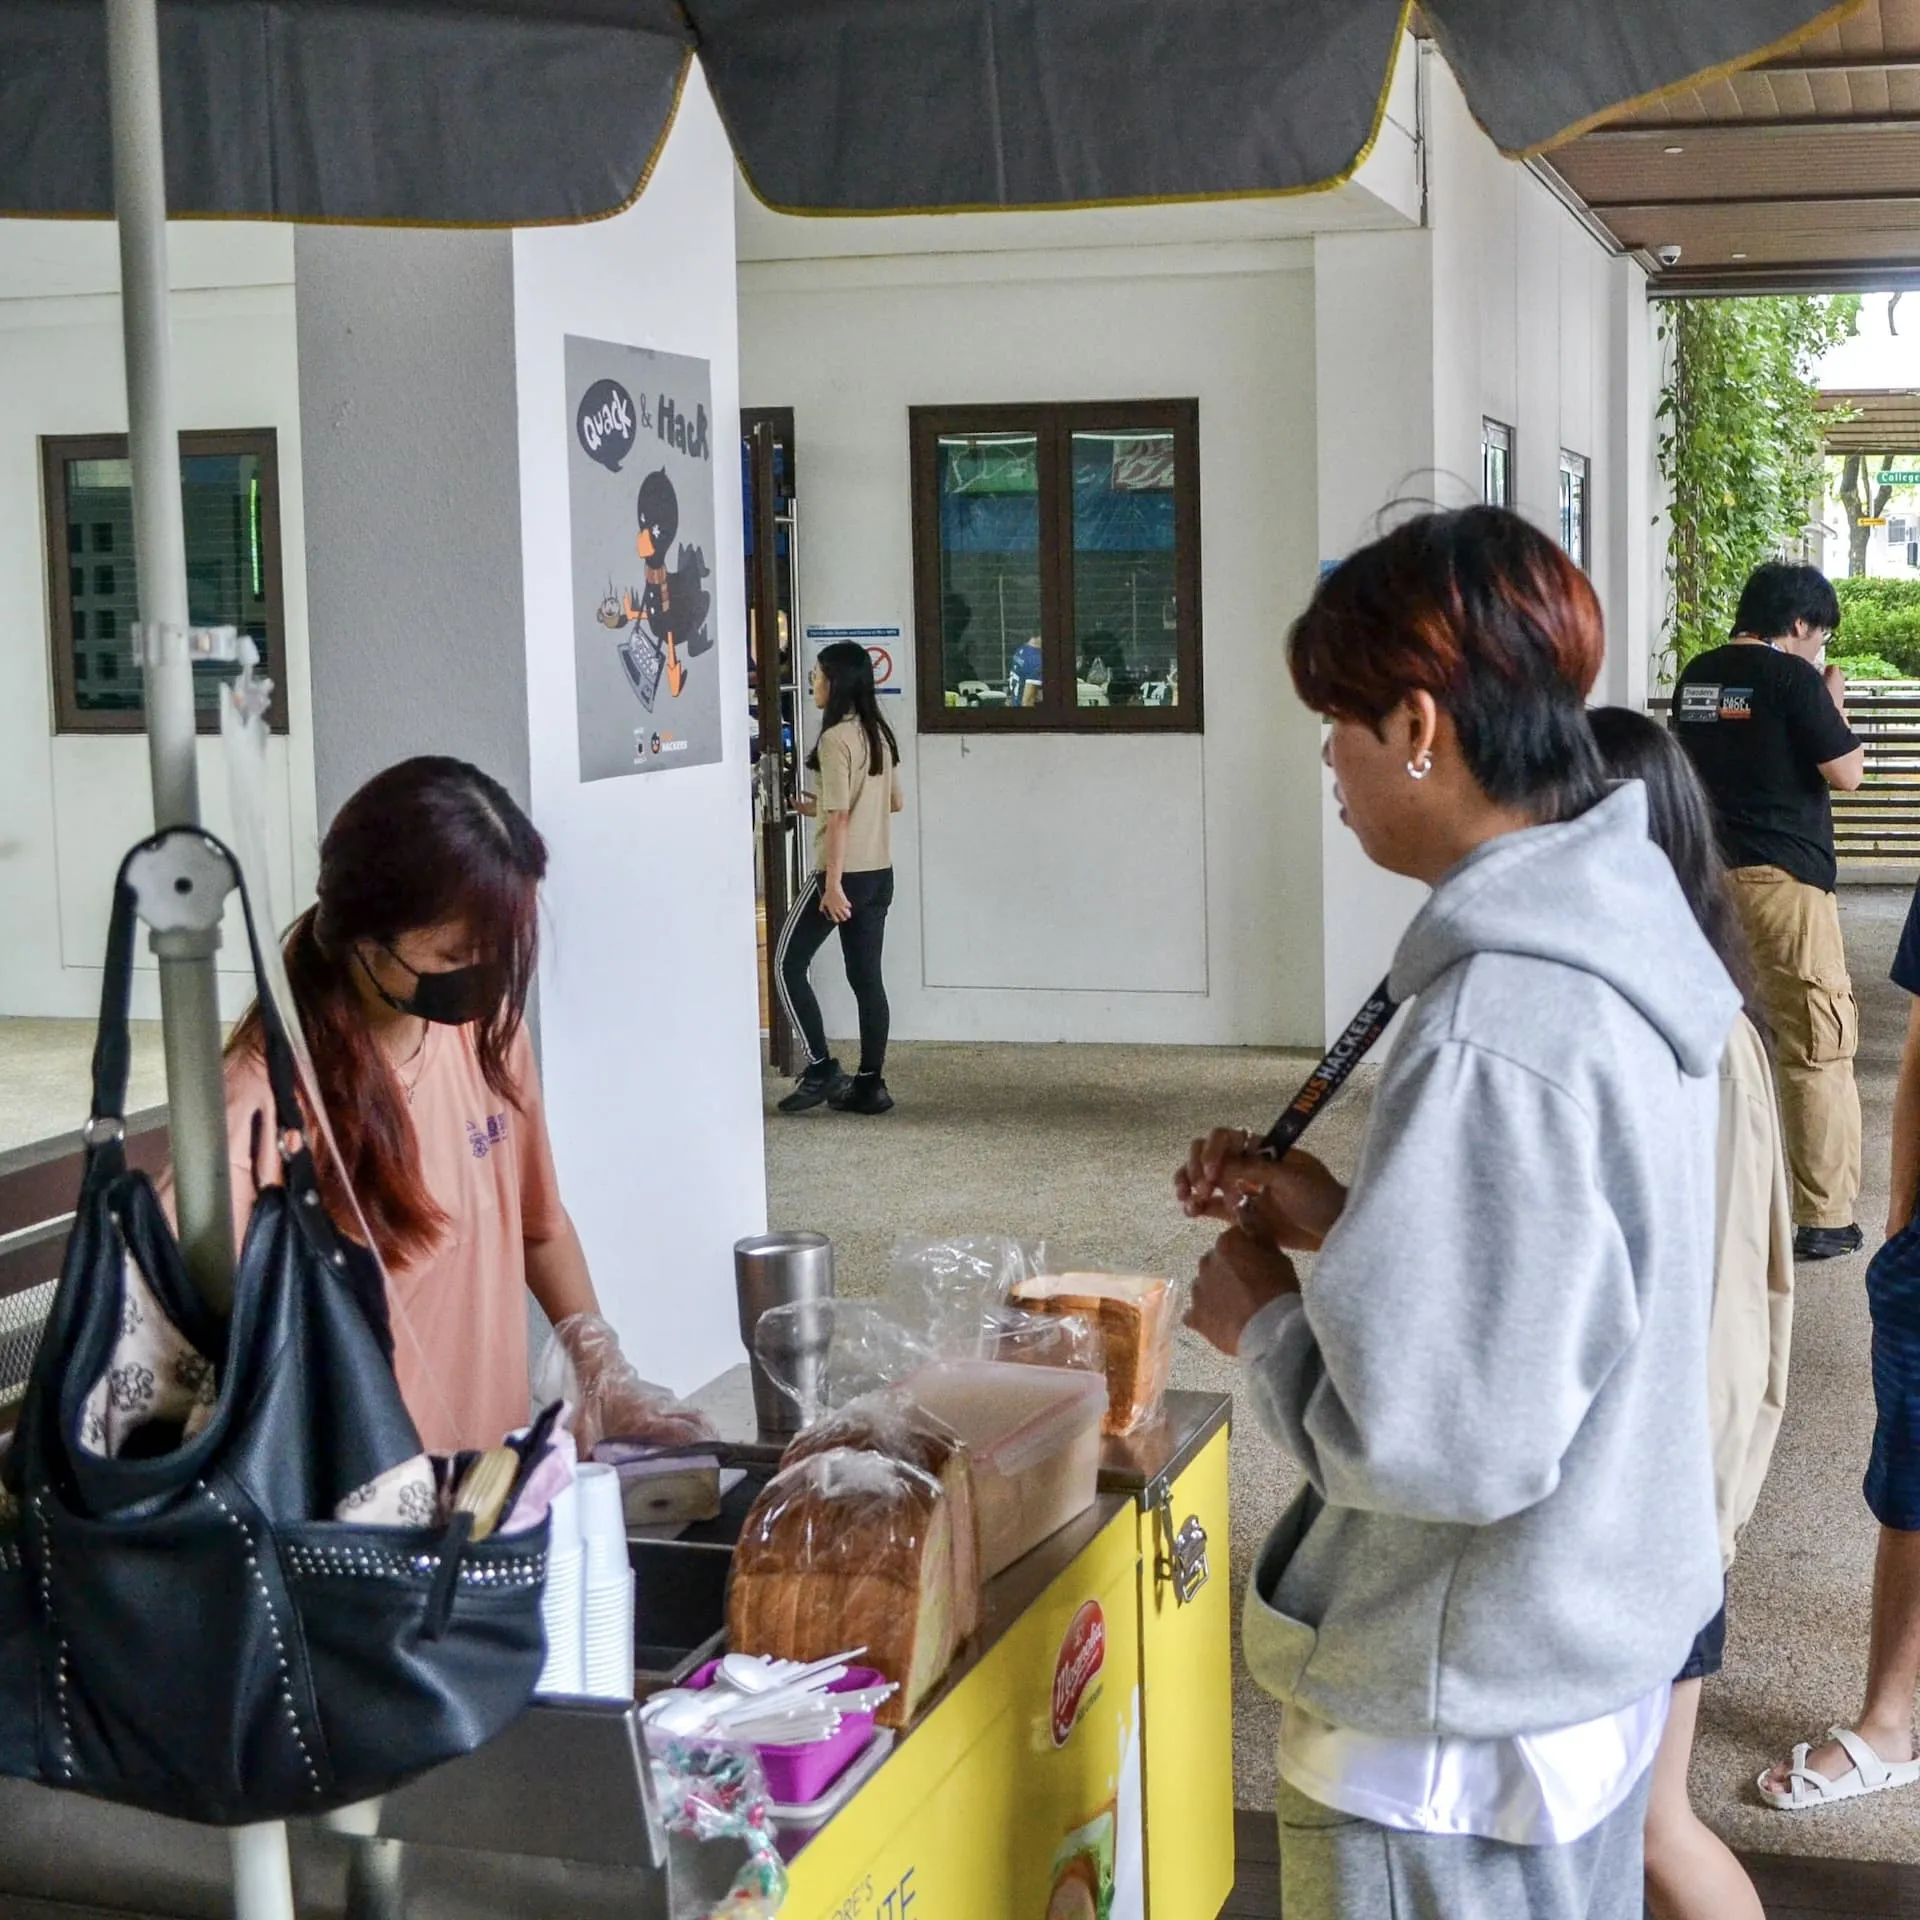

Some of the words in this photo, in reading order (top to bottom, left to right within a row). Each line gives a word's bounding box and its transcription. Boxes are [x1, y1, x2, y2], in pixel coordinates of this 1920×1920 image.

[584, 389, 632, 450] Quack
[641, 393, 652, 429] &
[658, 394, 709, 461] Hack
[1882, 473, 1920, 483] College
[1723, 696, 1746, 704] HACK
